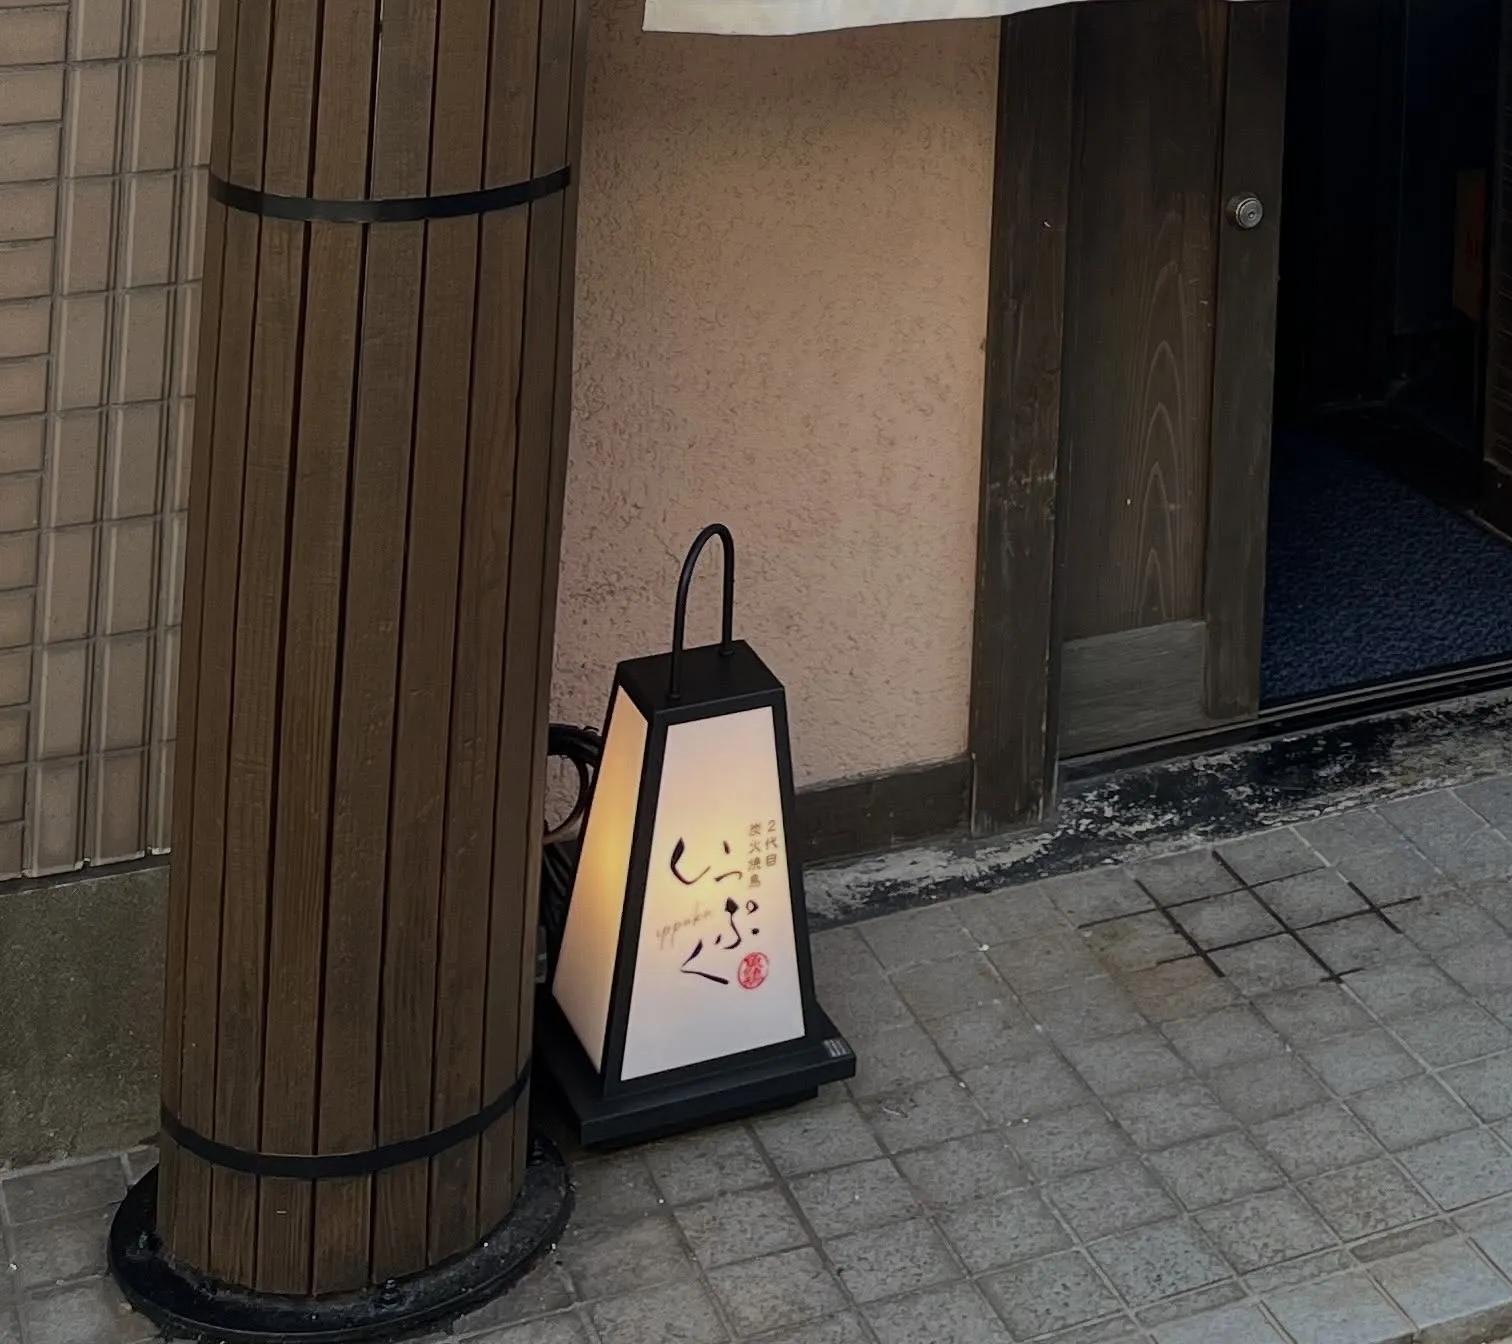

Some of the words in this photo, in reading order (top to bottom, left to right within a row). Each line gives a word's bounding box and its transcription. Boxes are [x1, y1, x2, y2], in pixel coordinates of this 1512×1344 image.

[765, 819, 779, 867] 2代目
[670, 837, 760, 985] いっぷく
